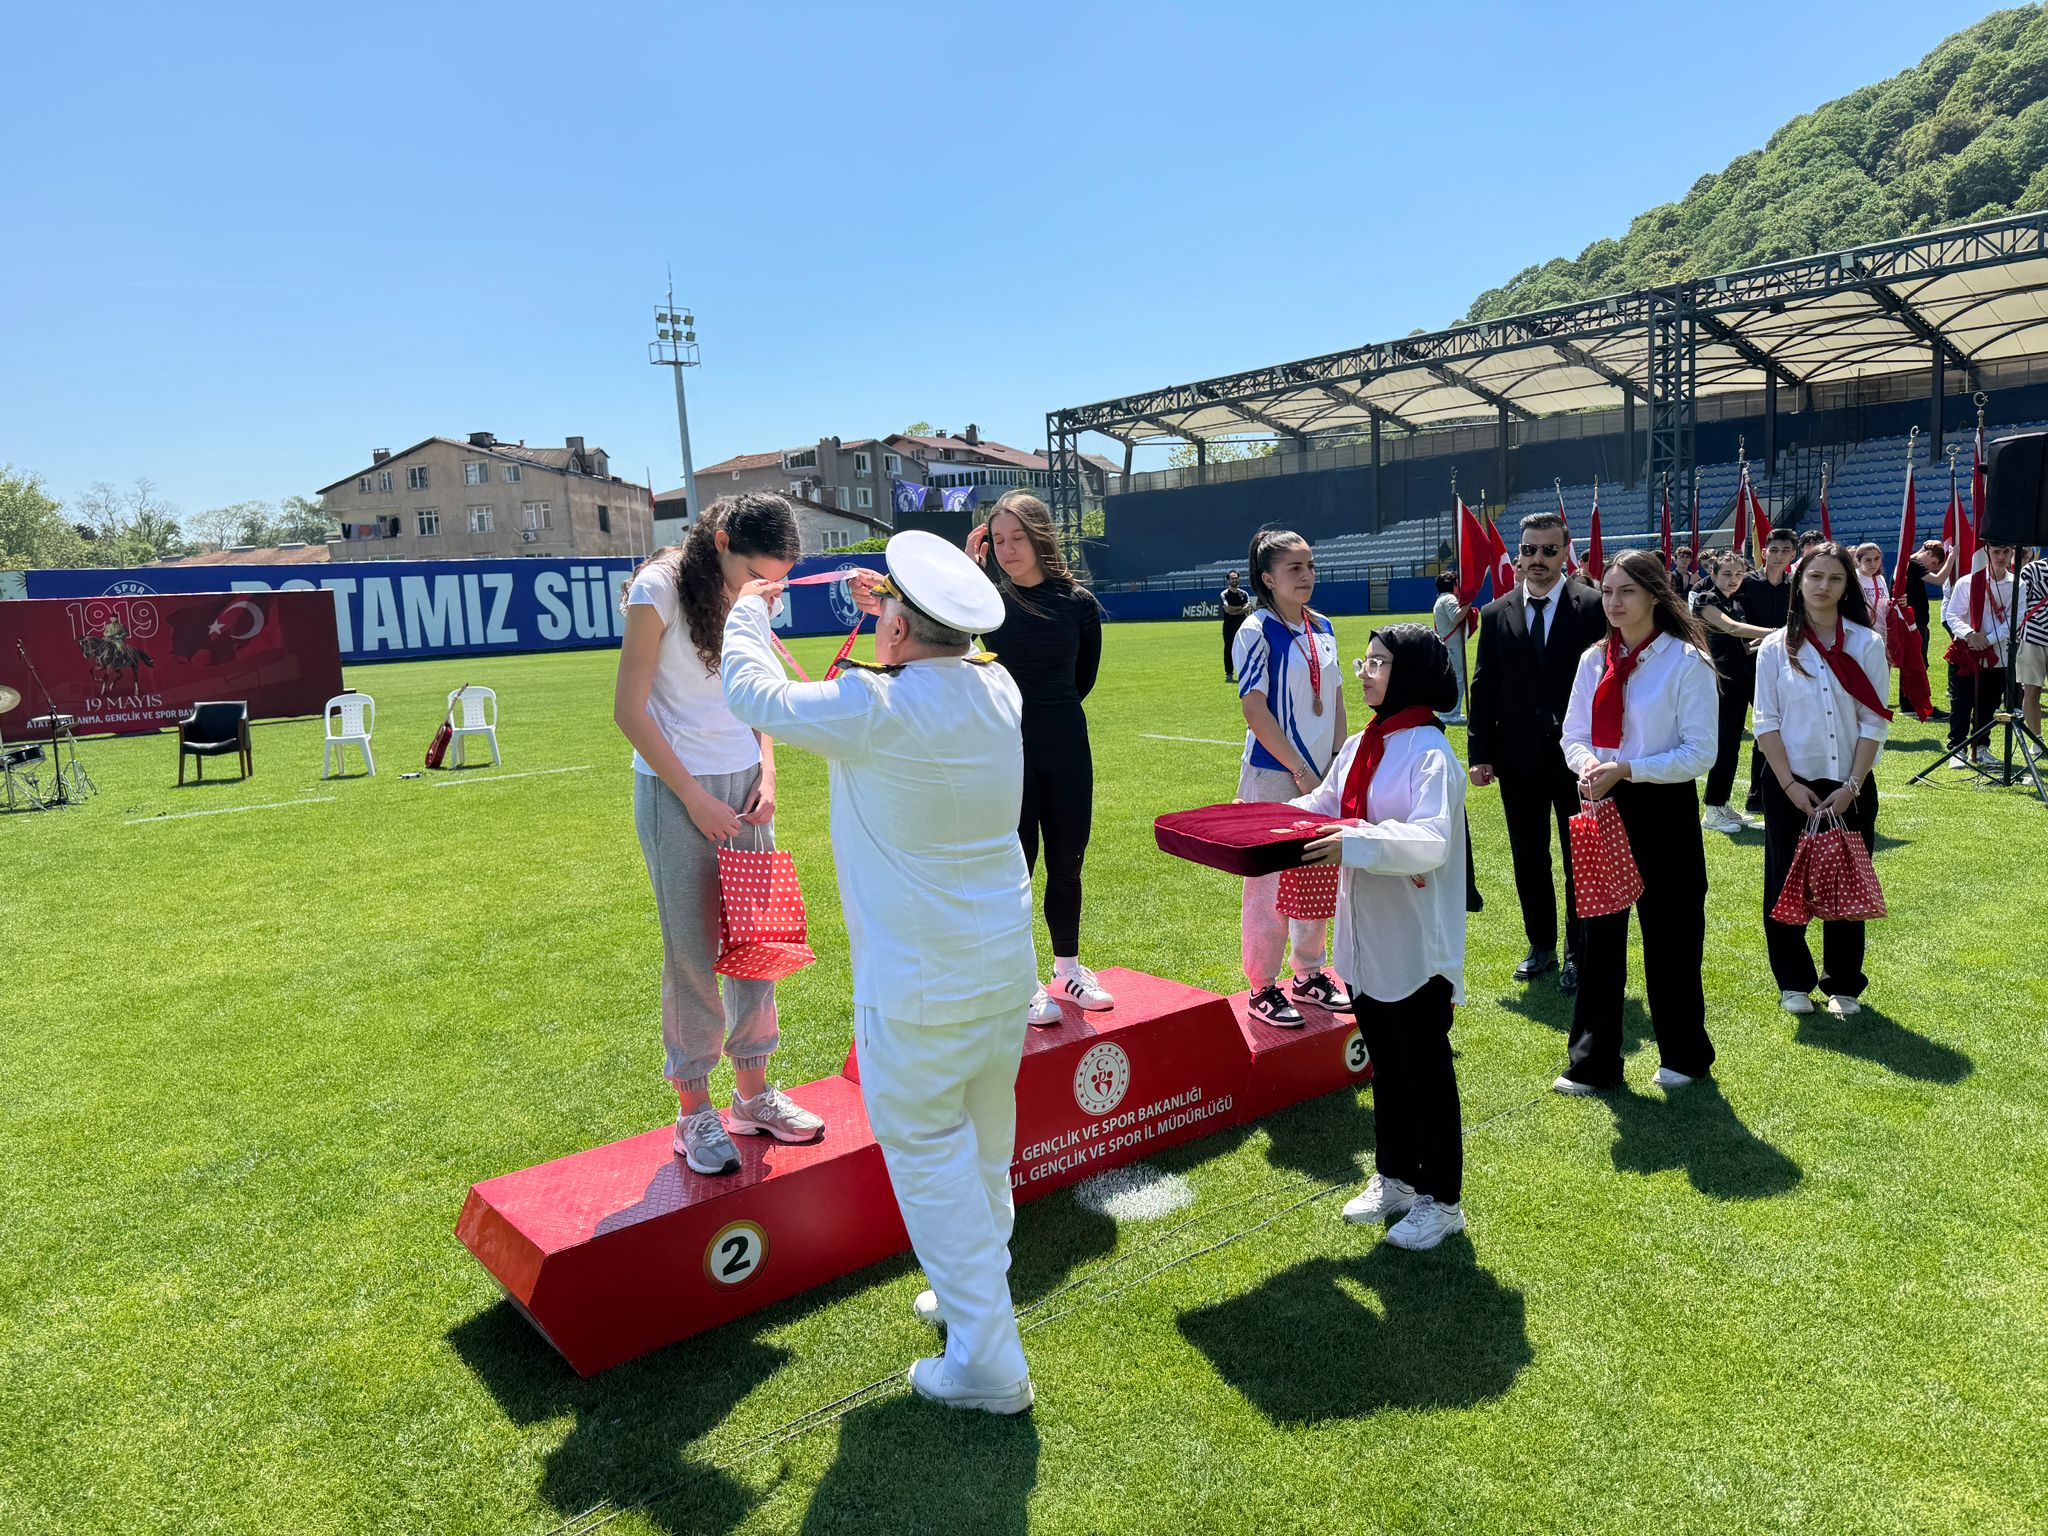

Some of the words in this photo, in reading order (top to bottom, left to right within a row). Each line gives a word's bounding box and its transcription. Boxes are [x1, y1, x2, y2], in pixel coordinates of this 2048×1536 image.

[113, 583, 146, 595] SPOR
[66, 600, 159, 640] 1919
[85, 697, 103, 712] 19
[107, 693, 163, 711] MAYIS
[105, 710, 142, 723] GENÇLİK
[142, 711, 153, 720] VE
[155, 709, 177, 719] SPOR
[1350, 1038, 1366, 1067] 3
[1021, 1129, 1081, 1162] GENÇLİK
[1082, 1123, 1100, 1141] VE
[1101, 1111, 1136, 1135] SPOR
[1138, 1085, 1202, 1122] BAKANLIĞI
[1029, 1148, 1088, 1181] GENÇLİK
[1089, 1142, 1107, 1160] VE
[1108, 1129, 1143, 1154] SPOR
[1144, 1123, 1156, 1141] İL
[1157, 1093, 1233, 1136] MÜDÜRLÜĞÜ
[721, 1235, 751, 1277] 2
